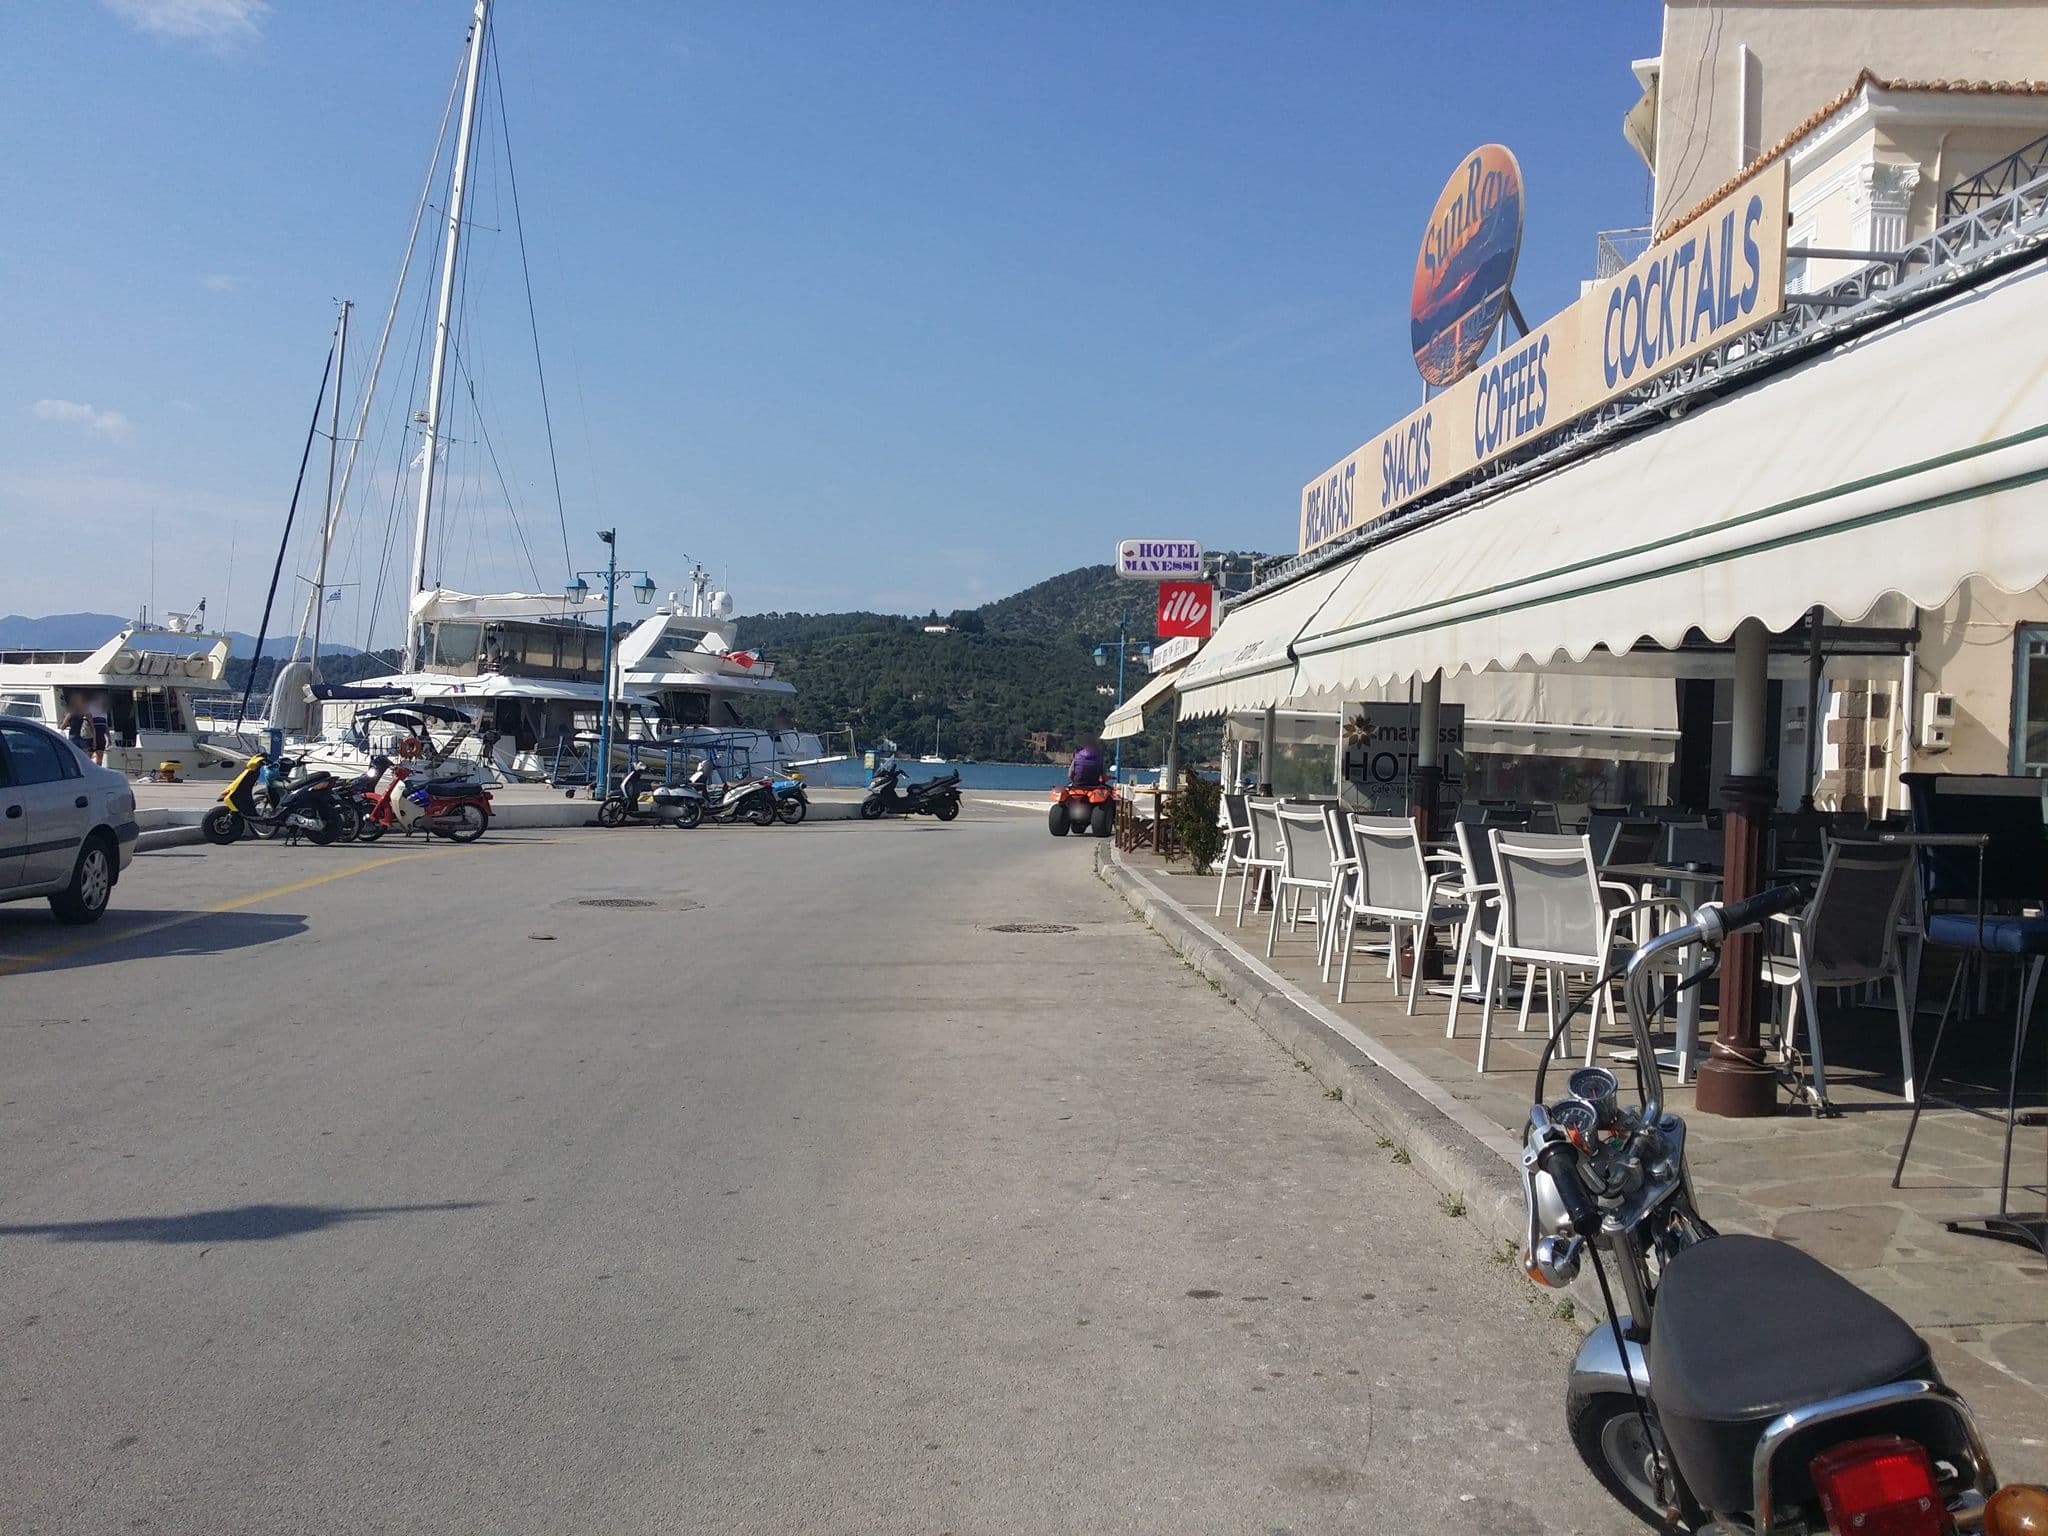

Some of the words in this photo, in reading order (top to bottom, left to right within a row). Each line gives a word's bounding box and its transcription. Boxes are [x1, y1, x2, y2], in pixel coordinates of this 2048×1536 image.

[1305, 462, 1357, 549] BREAKFAST
[1382, 412, 1433, 508] SNACKS
[1474, 333, 1550, 461] COFFEES
[1603, 195, 1763, 389] COCKTAILS
[1139, 543, 1200, 559] HOTEL
[1124, 560, 1200, 572] MANESSI
[1162, 590, 1208, 630] illy
[1378, 724, 1462, 743] manssi
[1345, 751, 1461, 783] HOTL
